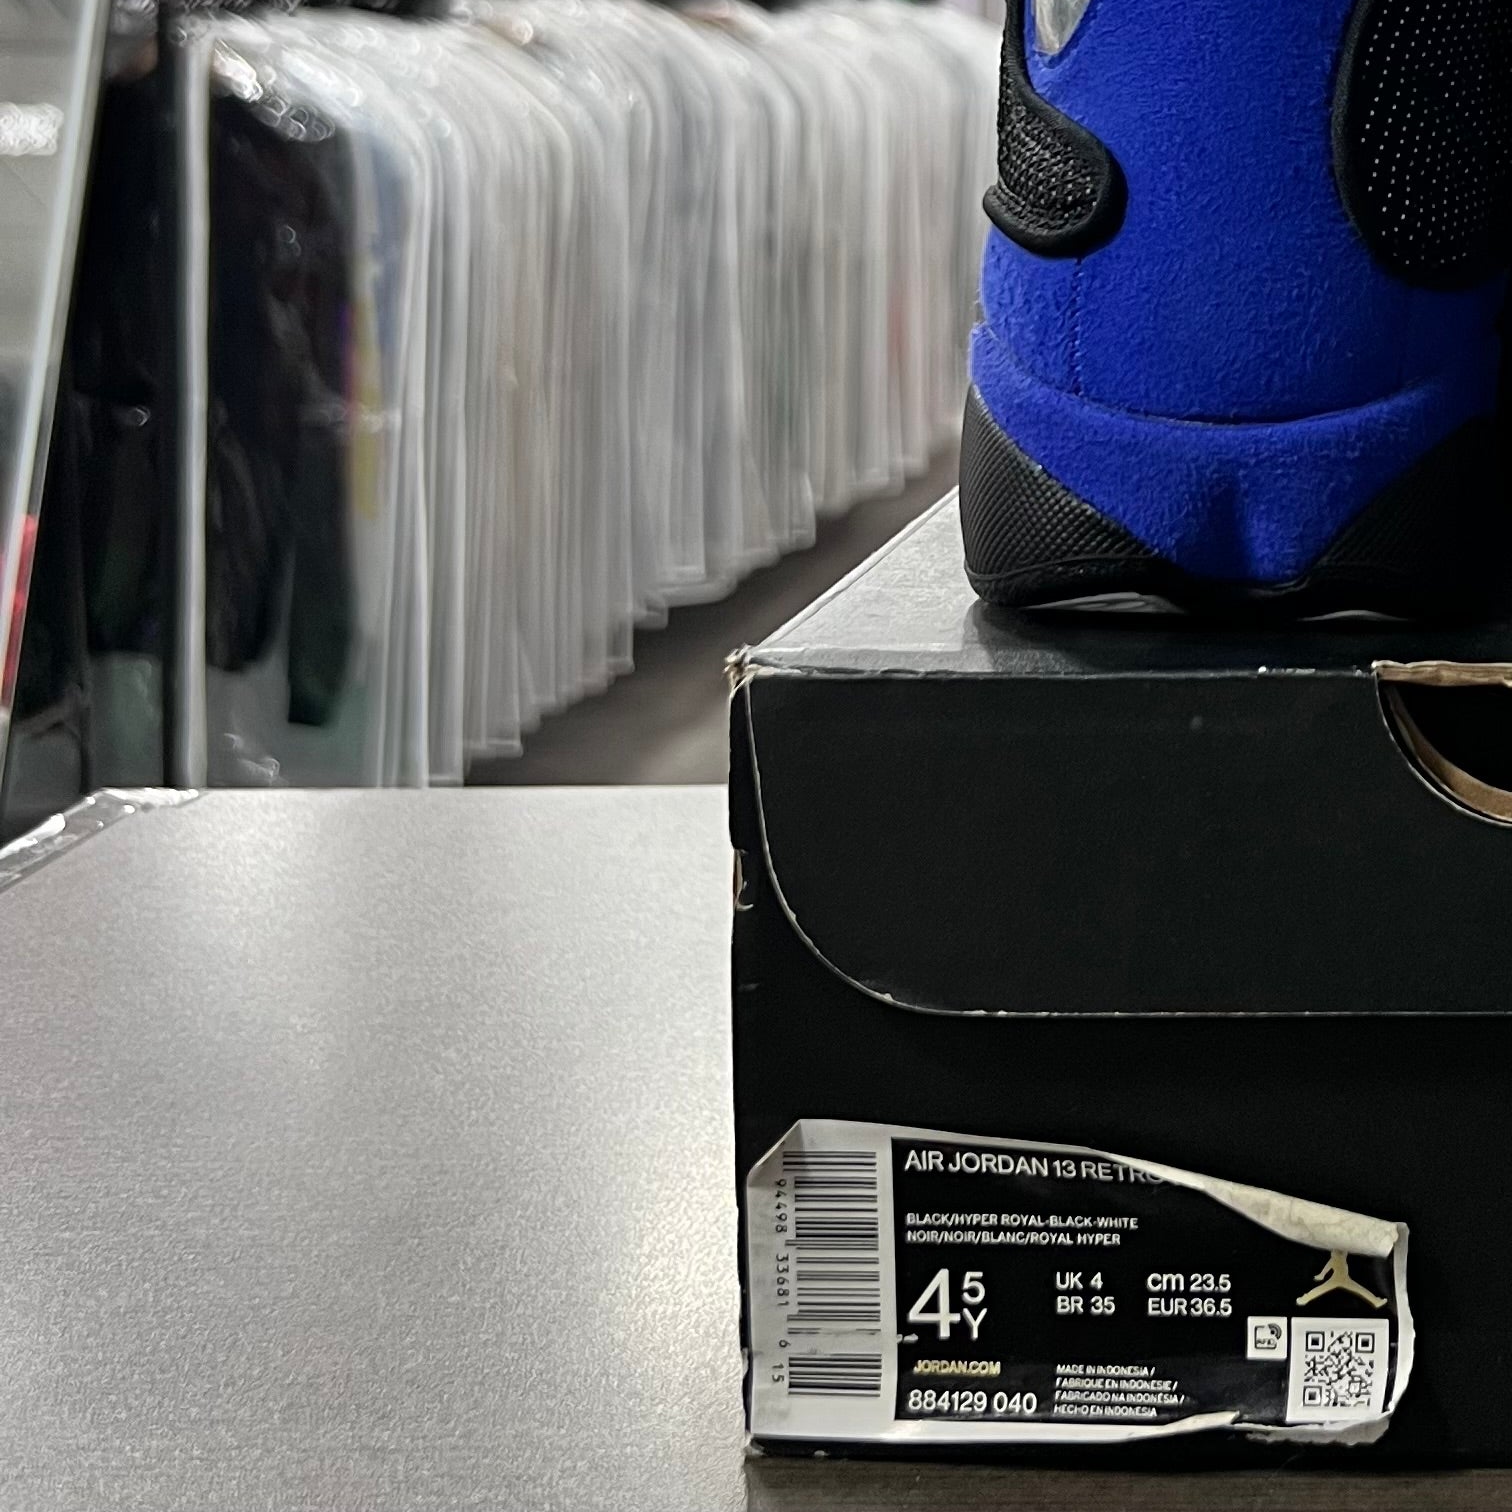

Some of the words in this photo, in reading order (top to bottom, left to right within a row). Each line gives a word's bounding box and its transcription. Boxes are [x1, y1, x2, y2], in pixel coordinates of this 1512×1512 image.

[905, 1150, 944, 1171] AIR
[949, 1152, 1049, 1176] JORDAN
[1053, 1160, 1077, 1179] 13
[775, 1178, 788, 1233] 94498
[906, 1212, 998, 1227] BLACK/HYPER
[1001, 1213, 1139, 1230] ROYAL-BLACK-WHITE
[907, 1230, 1073, 1245] NOIR/NOIR/BLANC/ROYAL
[1077, 1232, 1121, 1245] HYPER
[776, 1253, 790, 1306] 33681
[962, 1271, 986, 1305] 5
[1056, 1272, 1084, 1290] UK
[1090, 1272, 1104, 1290] 4
[1190, 1273, 1232, 1292] 23.5
[907, 1268, 961, 1339] 4
[1056, 1295, 1084, 1315] BR
[1090, 1295, 1115, 1315] 35
[1148, 1297, 1188, 1316] EUR
[1190, 1297, 1233, 1317] 36.5
[962, 1307, 988, 1340] Y
[913, 1360, 1001, 1376] JORDAN.COM
[1056, 1364, 1084, 1375] MADE
[1097, 1365, 1149, 1377] INDONESIA
[908, 1389, 988, 1412] 884129
[993, 1392, 1038, 1414] 040
